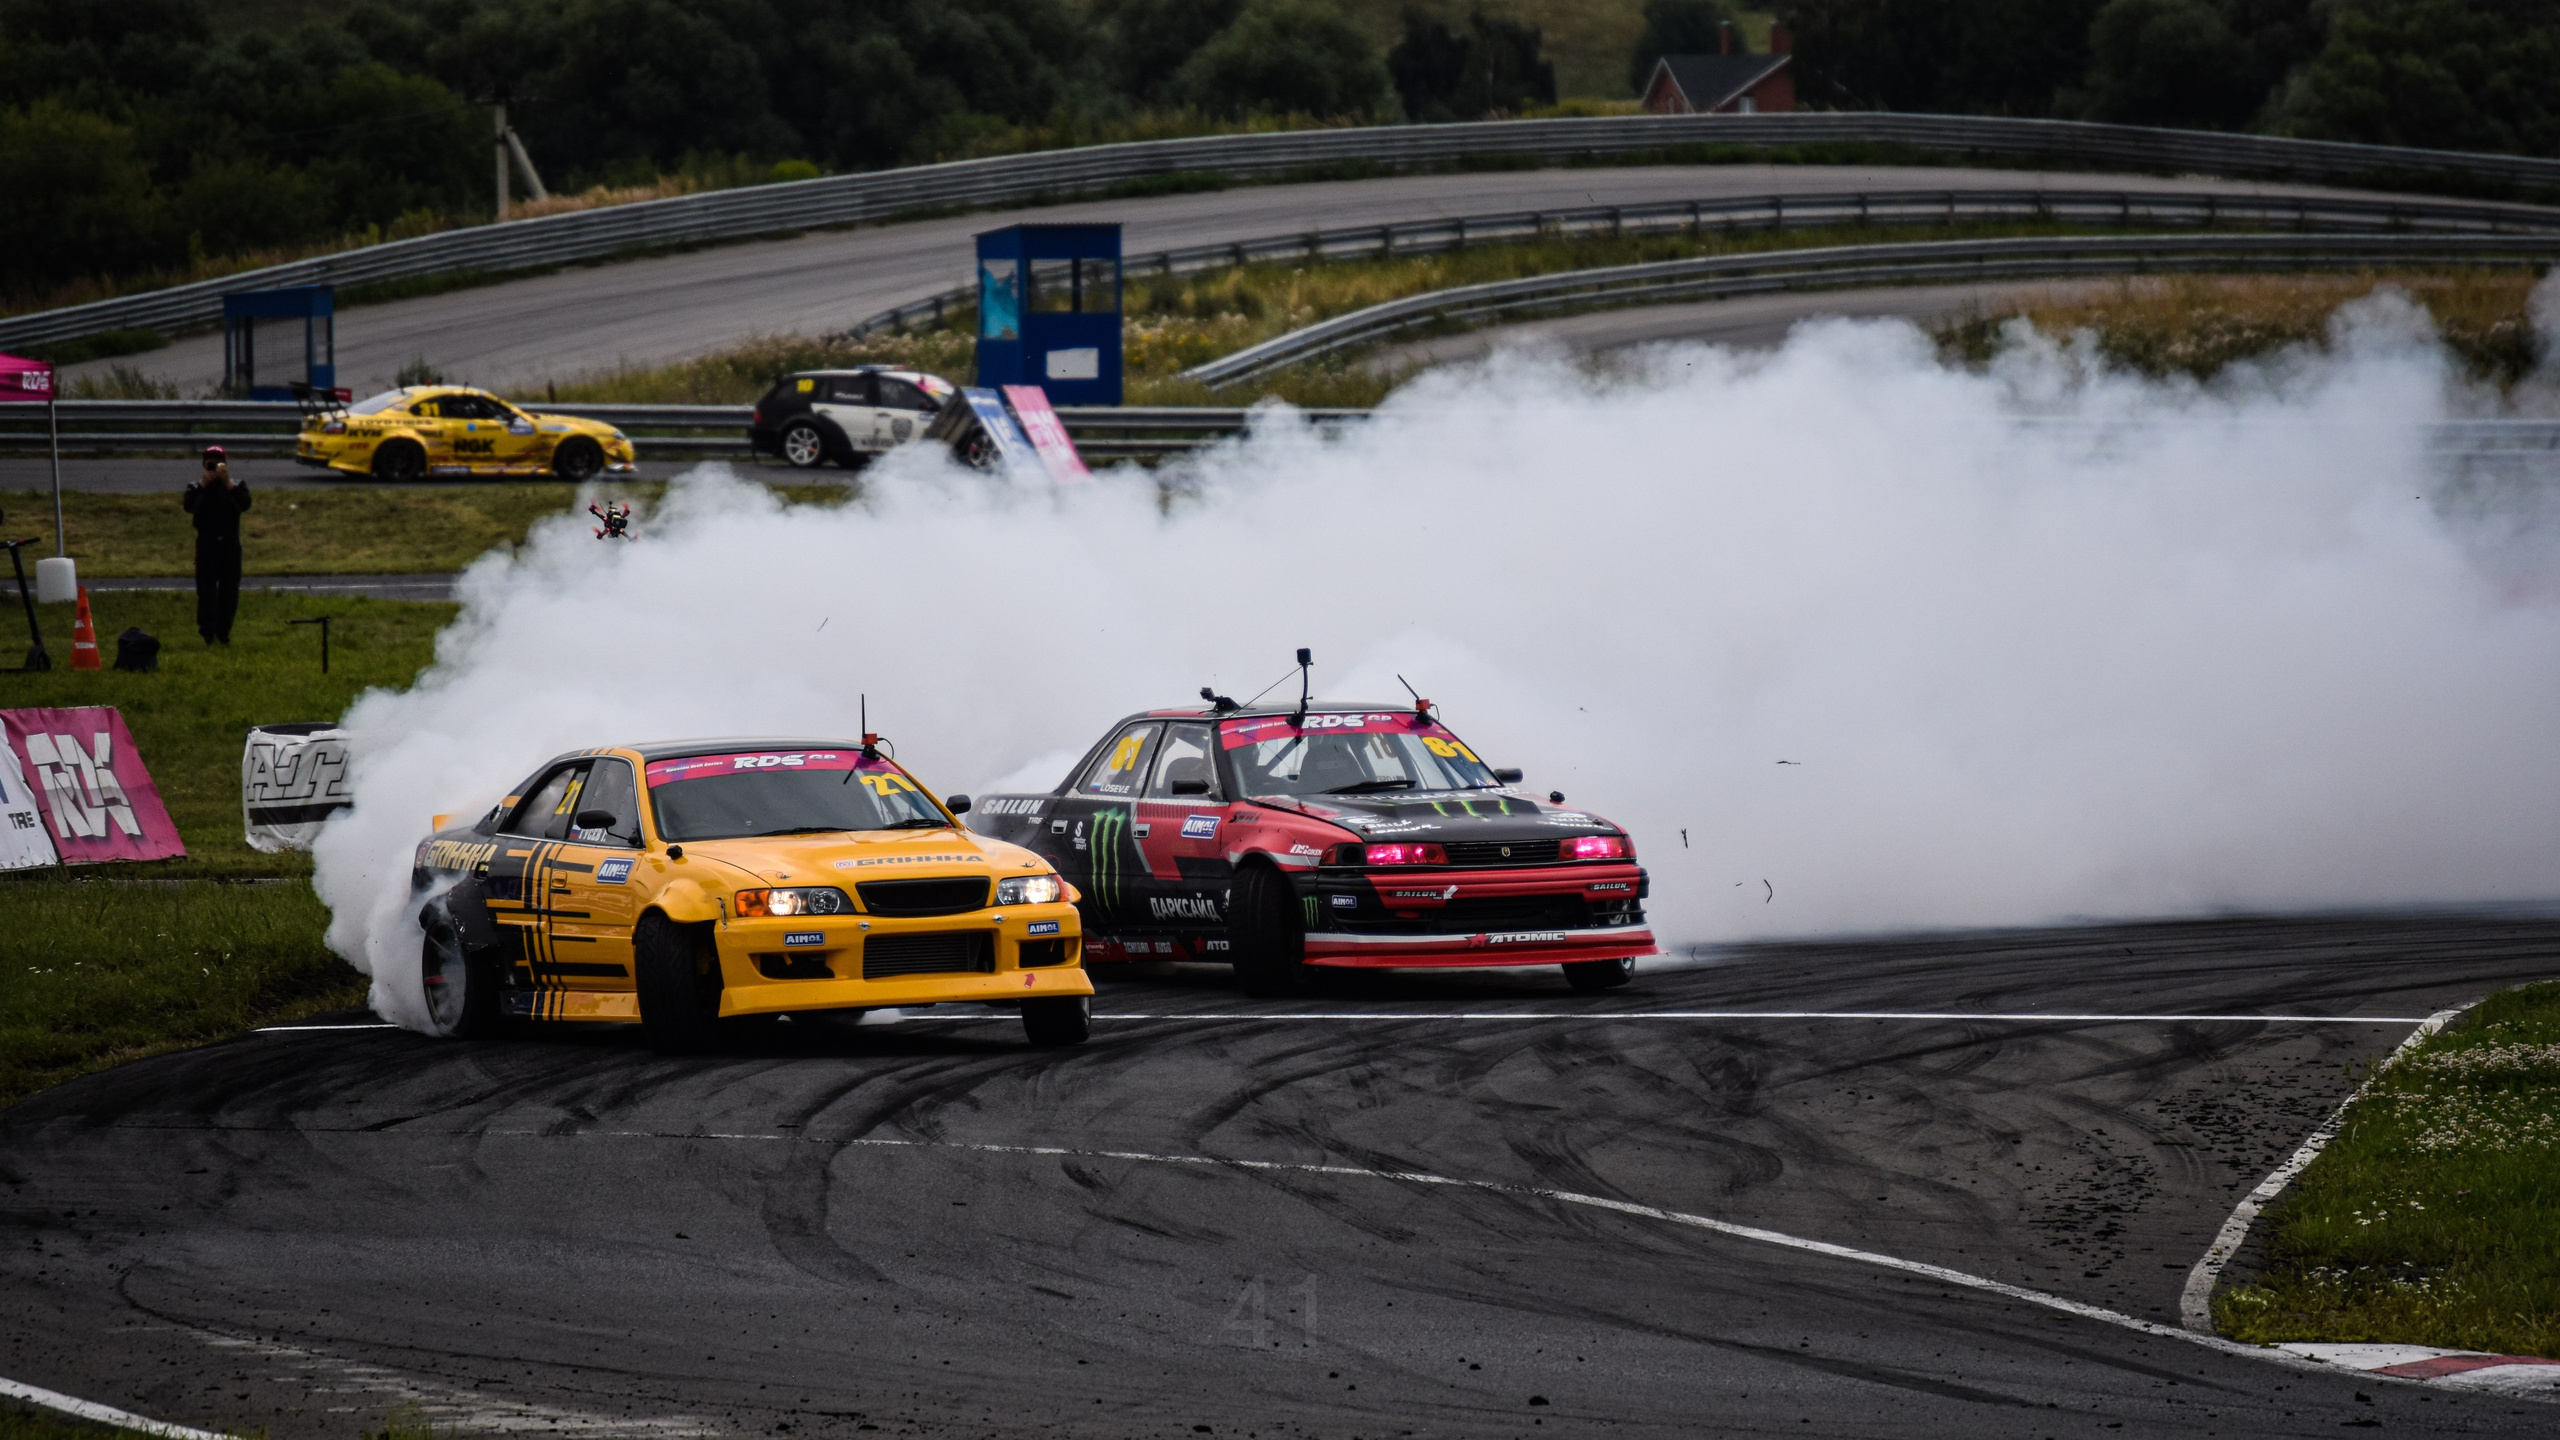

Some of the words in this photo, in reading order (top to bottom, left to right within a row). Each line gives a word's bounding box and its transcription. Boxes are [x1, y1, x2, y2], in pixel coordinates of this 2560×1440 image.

[22, 371, 51, 390] RDS
[454, 438, 495, 453] NGK
[1302, 714, 1365, 729] RDS
[1367, 714, 1393, 722] GP
[1110, 736, 1145, 771] 81
[1422, 736, 1480, 763] 81
[734, 754, 806, 769] RDS
[859, 772, 918, 797] 21
[554, 779, 584, 815] 21
[981, 800, 1045, 815] SAILUN
[1184, 820, 1215, 833] AIMOL
[856, 855, 984, 867] GRIHHHA
[599, 863, 629, 877] AIMOL
[1150, 892, 1223, 922] ДАРКСАЙД
[1029, 923, 1059, 933] AIMOL
[786, 934, 822, 944] AIMOL
[1489, 932, 1565, 943] ATOMIC
